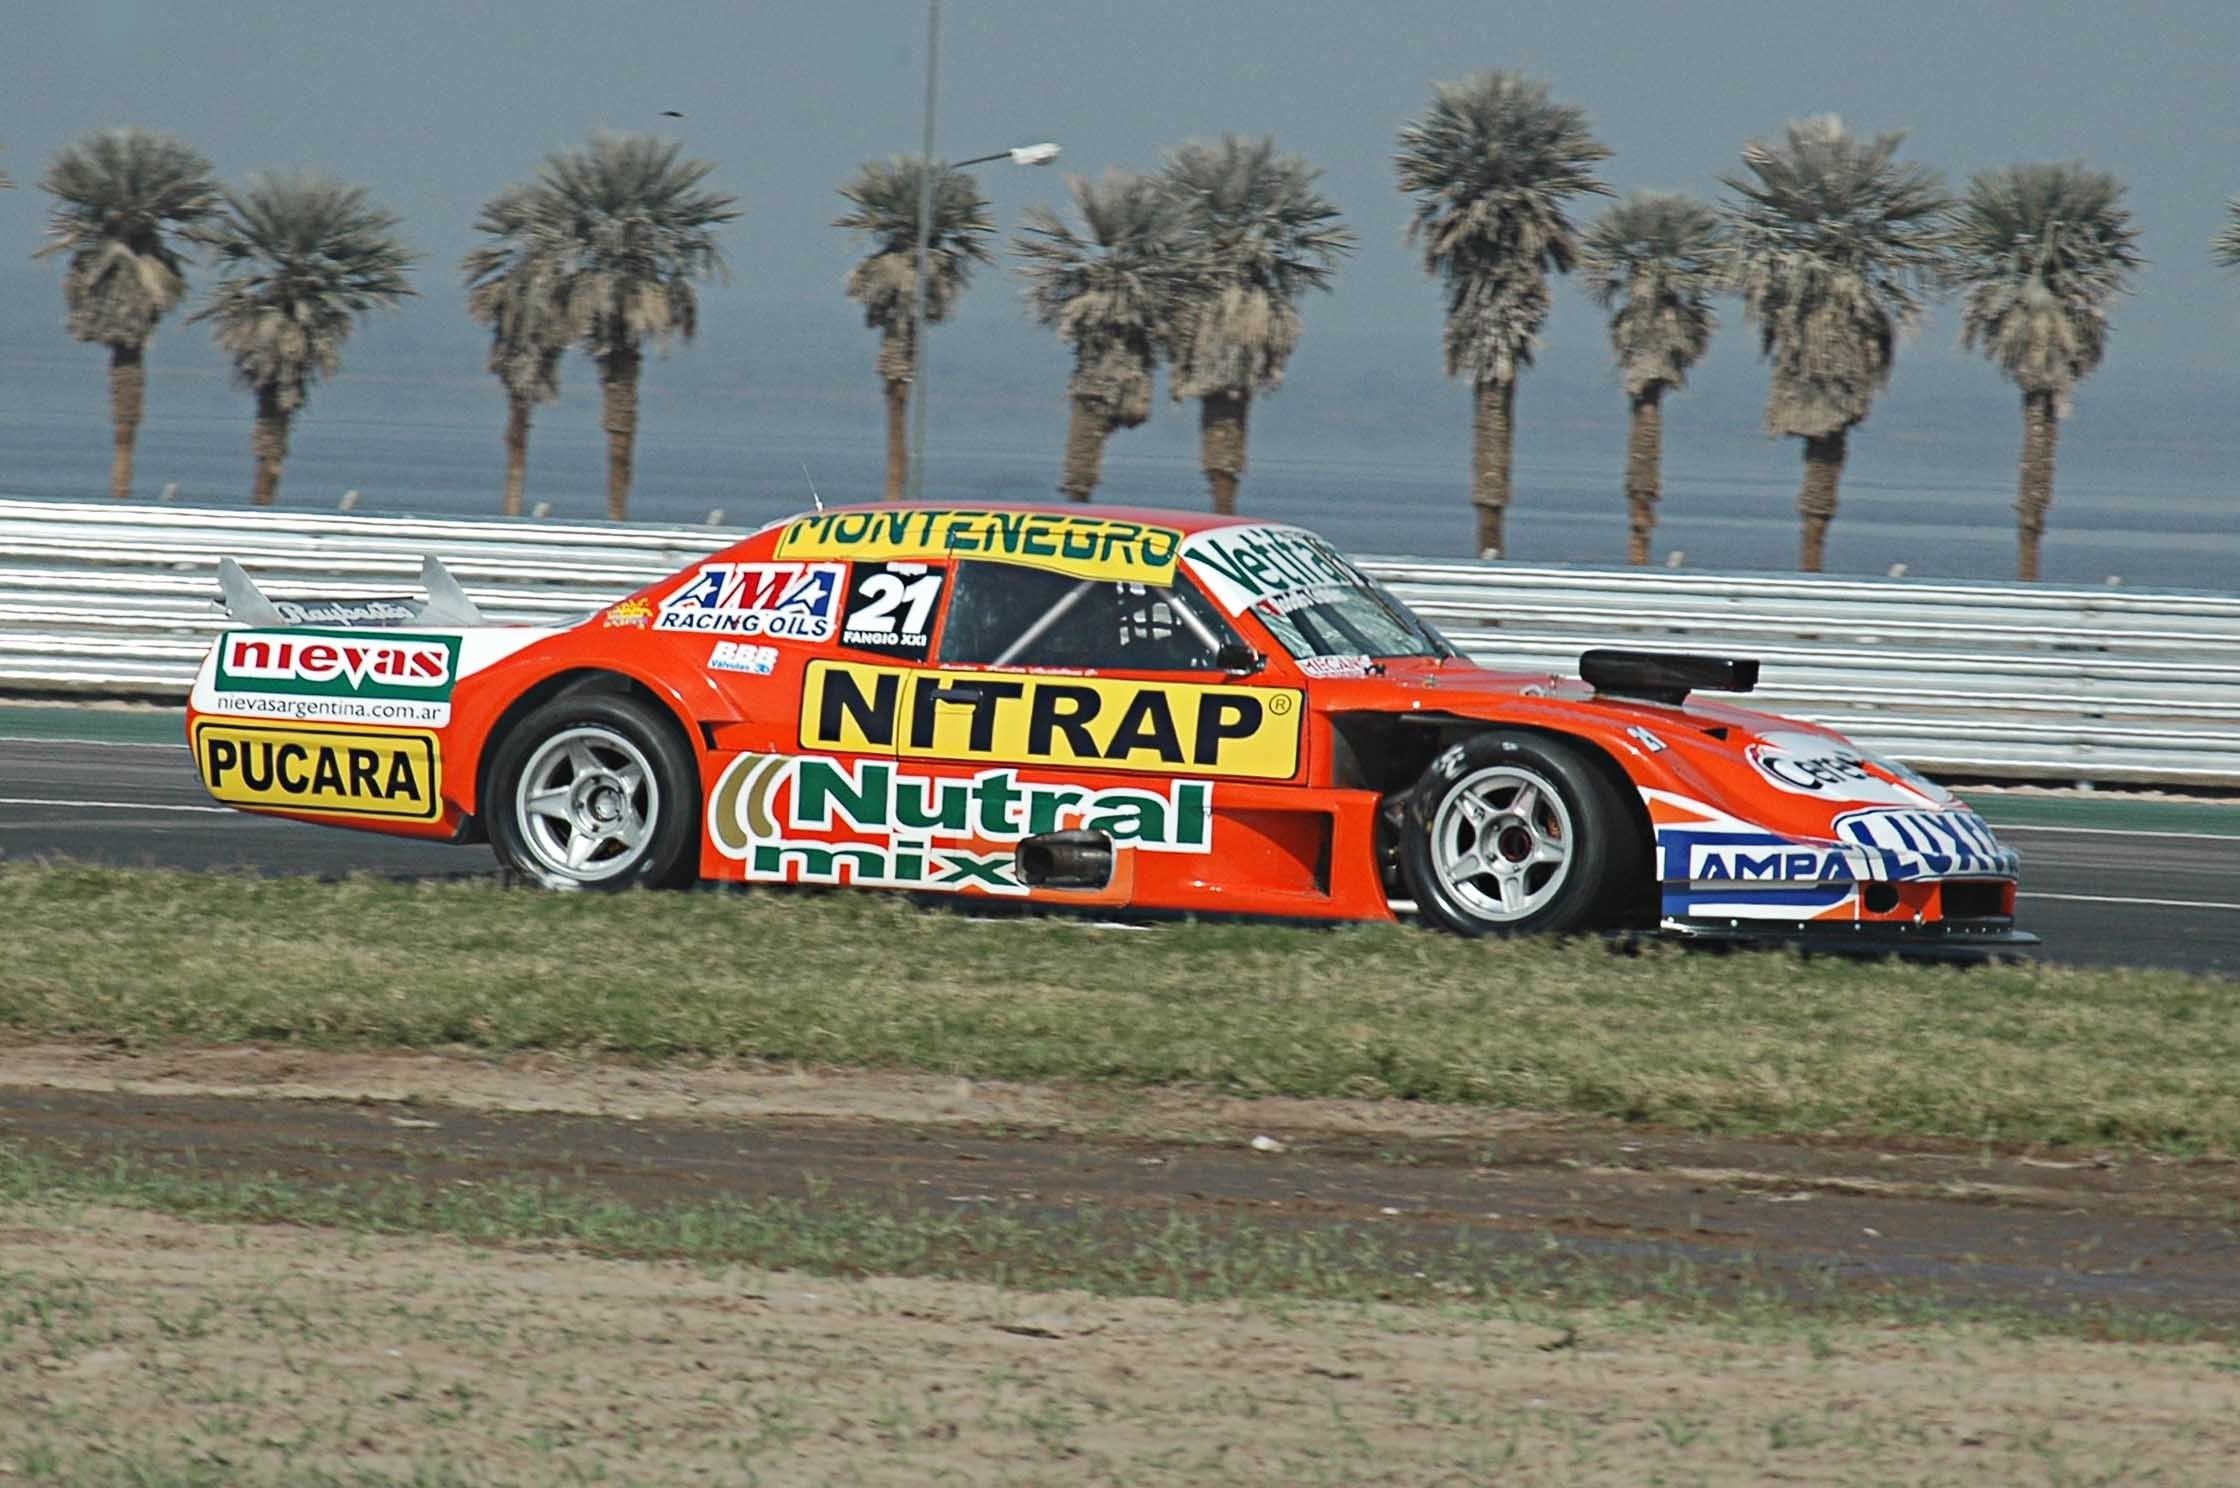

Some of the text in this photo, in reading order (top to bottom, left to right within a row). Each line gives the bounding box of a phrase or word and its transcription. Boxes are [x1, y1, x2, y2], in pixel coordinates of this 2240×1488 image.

[788, 510, 1181, 567] MONTENEGRO
[661, 611, 760, 632] RACING
[769, 613, 828, 637] OILS
[846, 573, 943, 634] 21
[232, 640, 443, 679] nievas
[843, 631, 928, 647] FANGIO XXI
[216, 695, 441, 720] nievasargentina.com.ar
[818, 668, 1264, 766] NITRAP
[207, 738, 422, 801] PUCARA
[797, 760, 1206, 845] Nutral
[752, 838, 1020, 887] mix
[1697, 852, 1856, 880] AMPA
